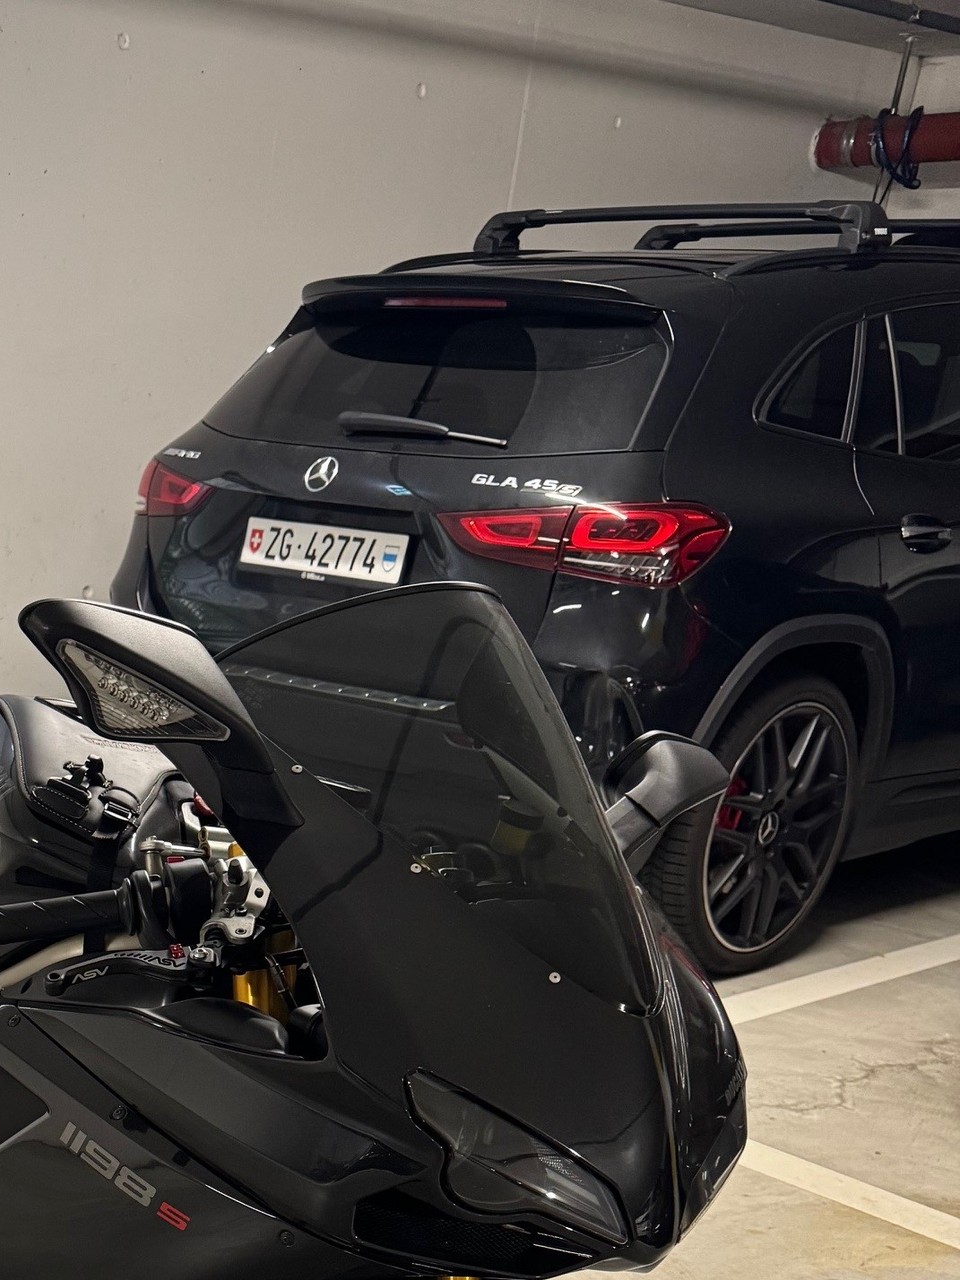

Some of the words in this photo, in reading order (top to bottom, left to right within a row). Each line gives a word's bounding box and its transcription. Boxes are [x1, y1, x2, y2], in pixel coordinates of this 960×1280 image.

[470, 473, 519, 489] GLA
[71, 965, 110, 984] ASV
[59, 1121, 157, 1208] 1198
[156, 1201, 191, 1231] S
